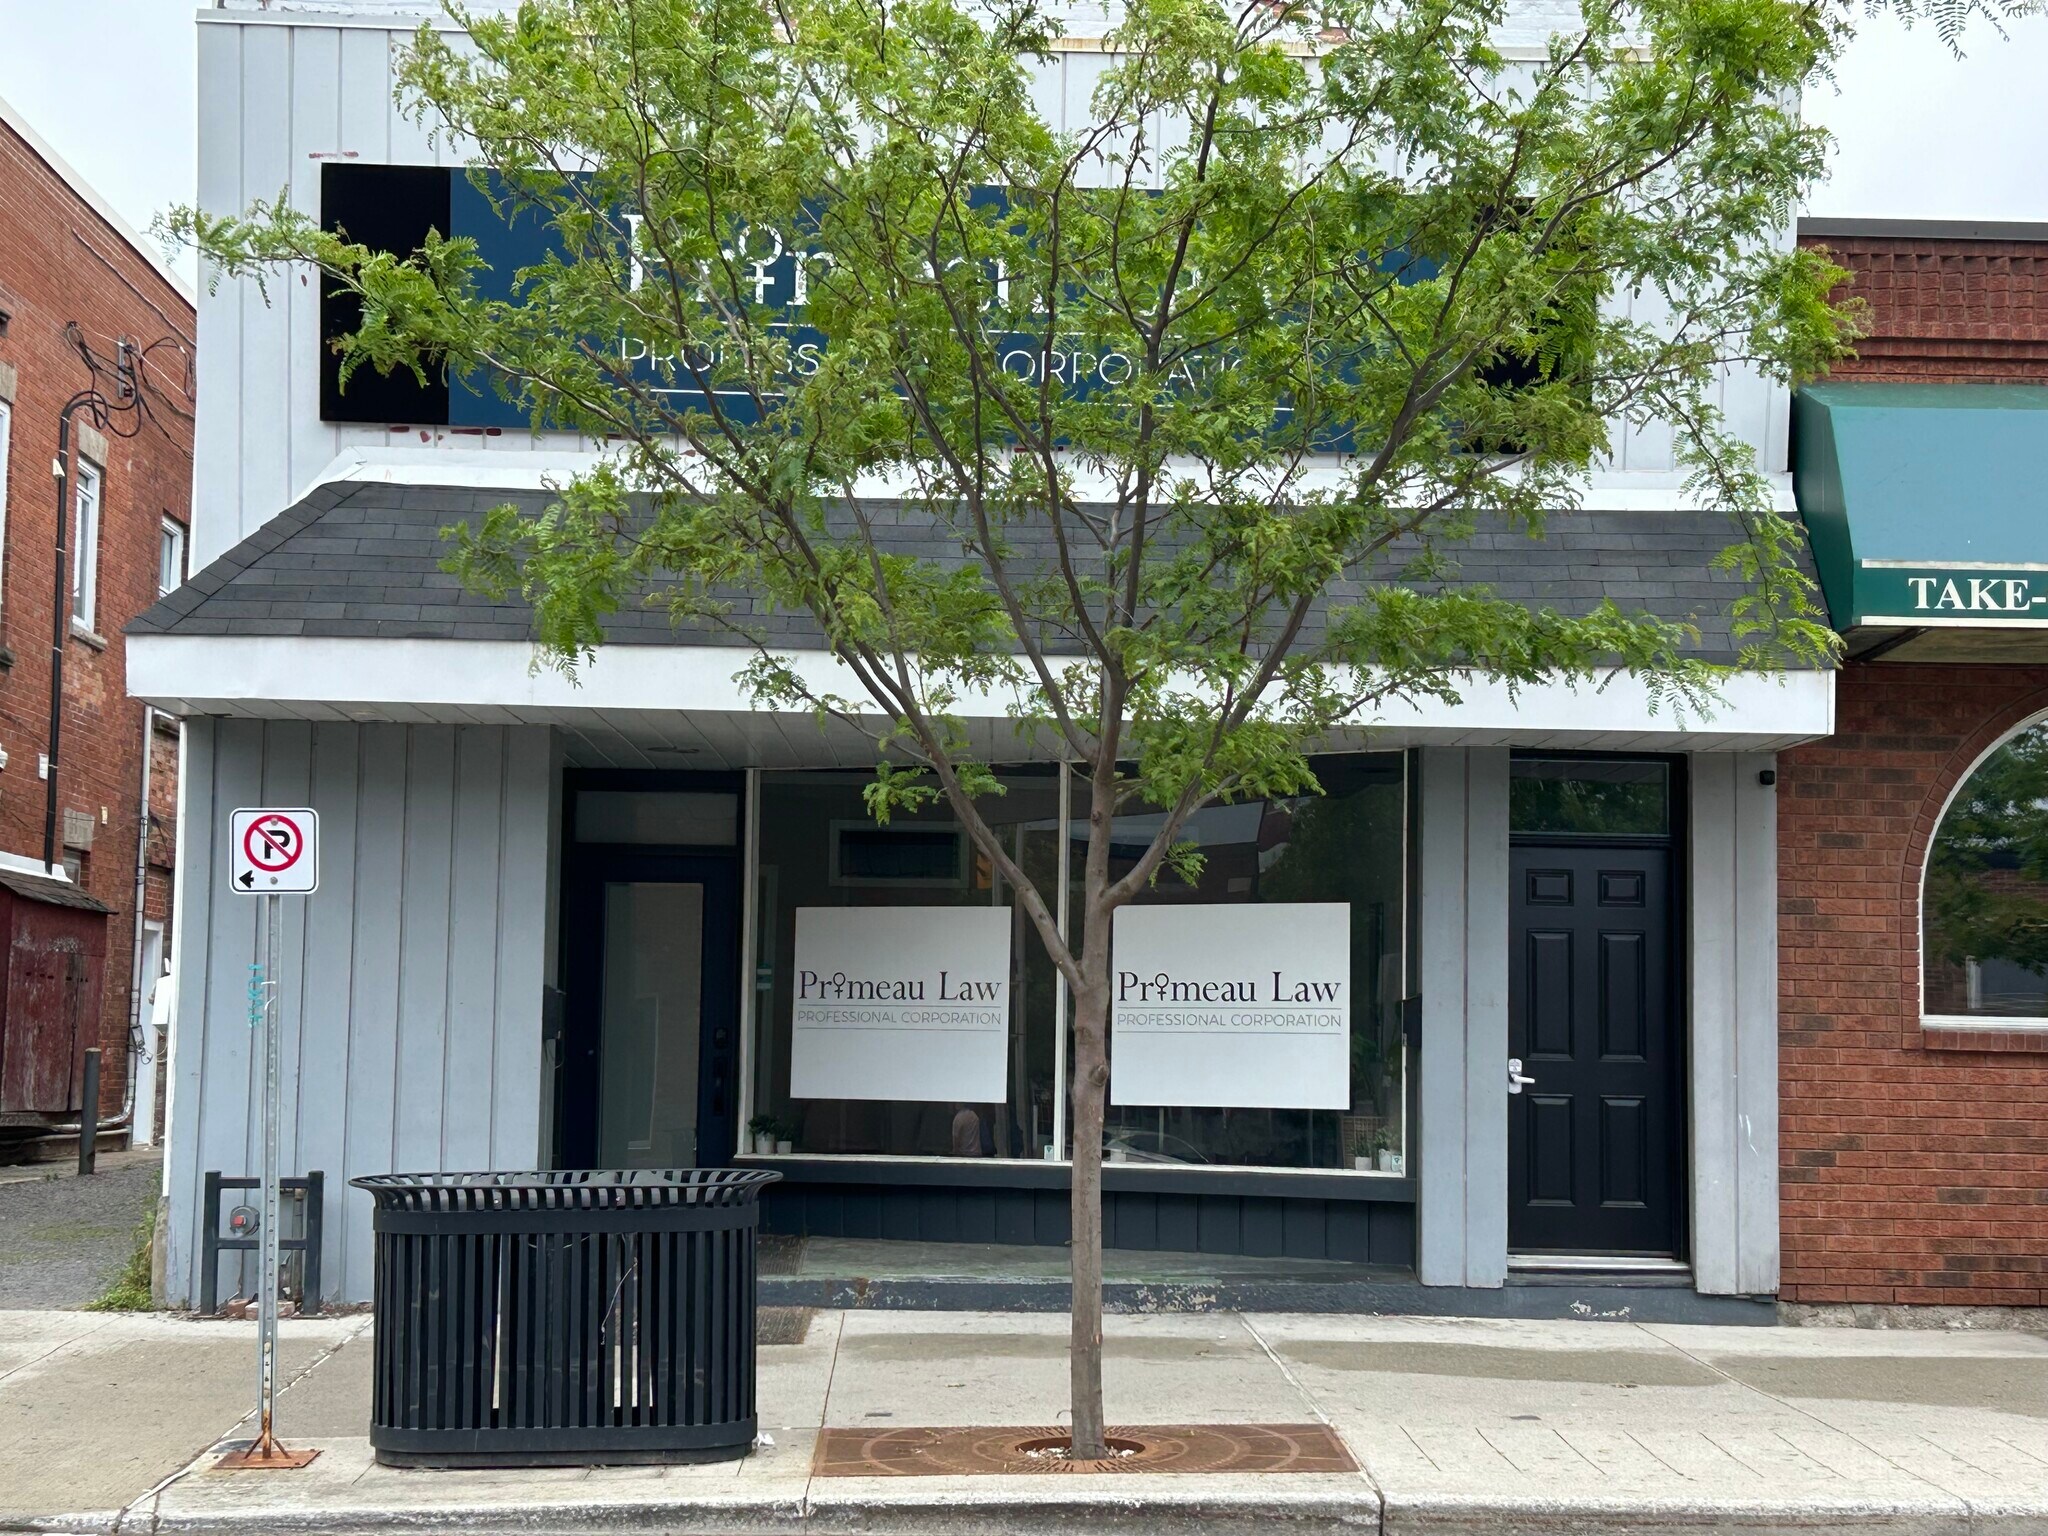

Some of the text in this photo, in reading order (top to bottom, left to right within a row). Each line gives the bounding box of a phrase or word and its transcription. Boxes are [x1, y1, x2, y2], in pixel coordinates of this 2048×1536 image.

[1907, 577, 2047, 611] TAKE-
[799, 970, 1002, 1001] Primeau Law
[1117, 971, 1342, 1003] Primeau Law
[797, 1010, 1001, 1026] PROFESSIONAL CORPORATION
[1117, 1013, 1342, 1028] PROFESSIONAL CORPORATION
